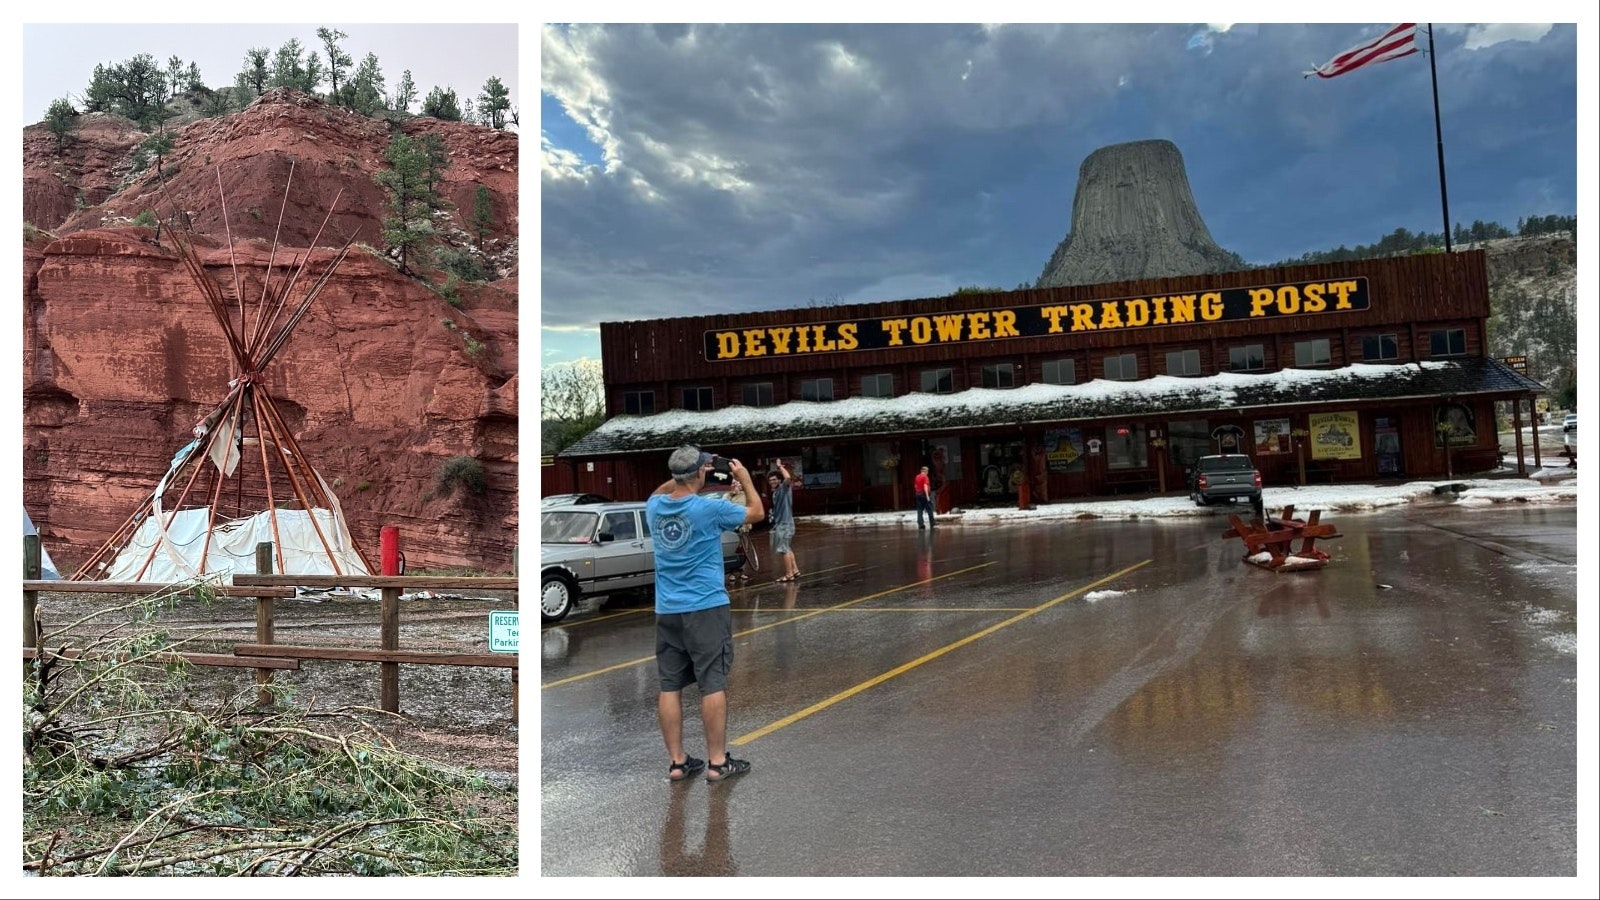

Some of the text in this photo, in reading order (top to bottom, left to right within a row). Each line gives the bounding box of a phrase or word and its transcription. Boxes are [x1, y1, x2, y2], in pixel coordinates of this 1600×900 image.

[717, 281, 1357, 359] DEVILS TOWER TRADING POST
